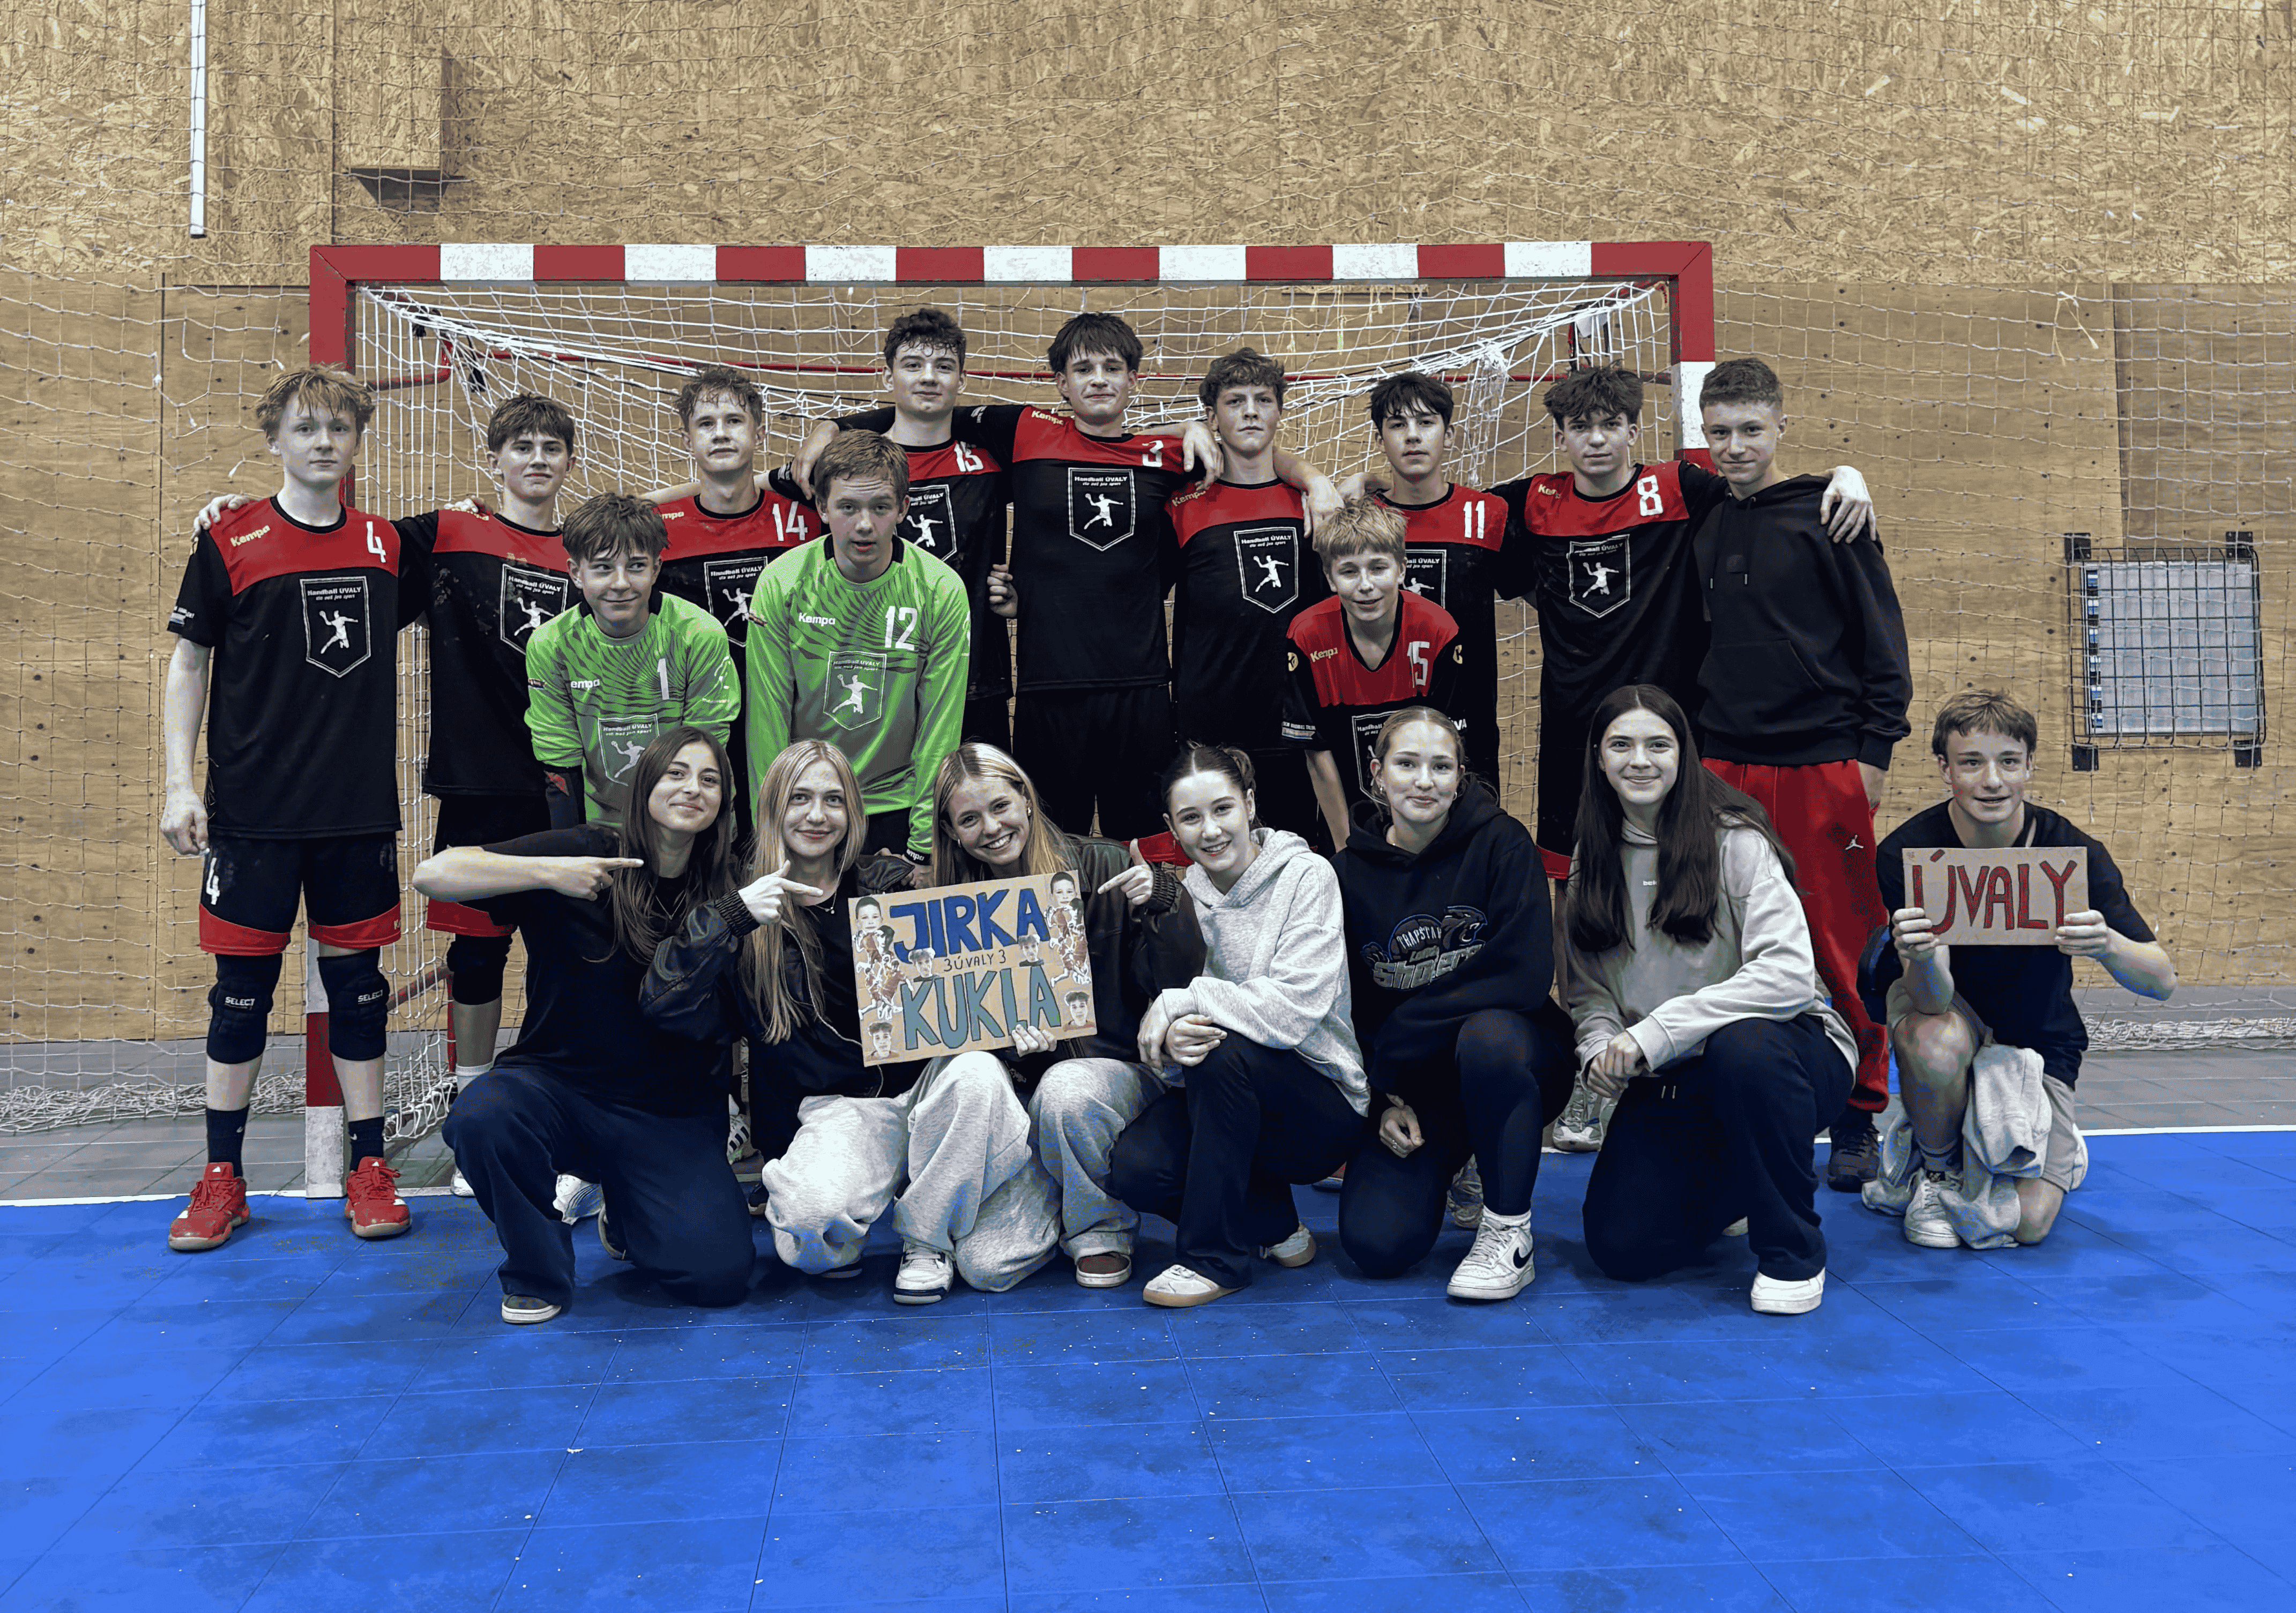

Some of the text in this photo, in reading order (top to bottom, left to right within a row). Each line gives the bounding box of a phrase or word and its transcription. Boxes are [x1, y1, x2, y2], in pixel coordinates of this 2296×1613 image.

[1142, 440, 1164, 467] 3
[1637, 474, 1664, 516] 8
[230, 525, 271, 547] Kempa
[772, 501, 808, 542] 14
[1463, 501, 1485, 539] 11
[367, 521, 386, 563] 4
[798, 613, 836, 626] Kempa
[884, 606, 918, 651] 12
[657, 658, 670, 700] 1
[1407, 641, 1430, 689] 15
[206, 857, 220, 905] 4
[1912, 849, 2077, 935] ÚVALY
[890, 888, 1050, 965] JIRKA
[225, 996, 256, 1006] SELECT
[357, 989, 383, 1003] SELECT
[900, 965, 1061, 1051] KUKLA
